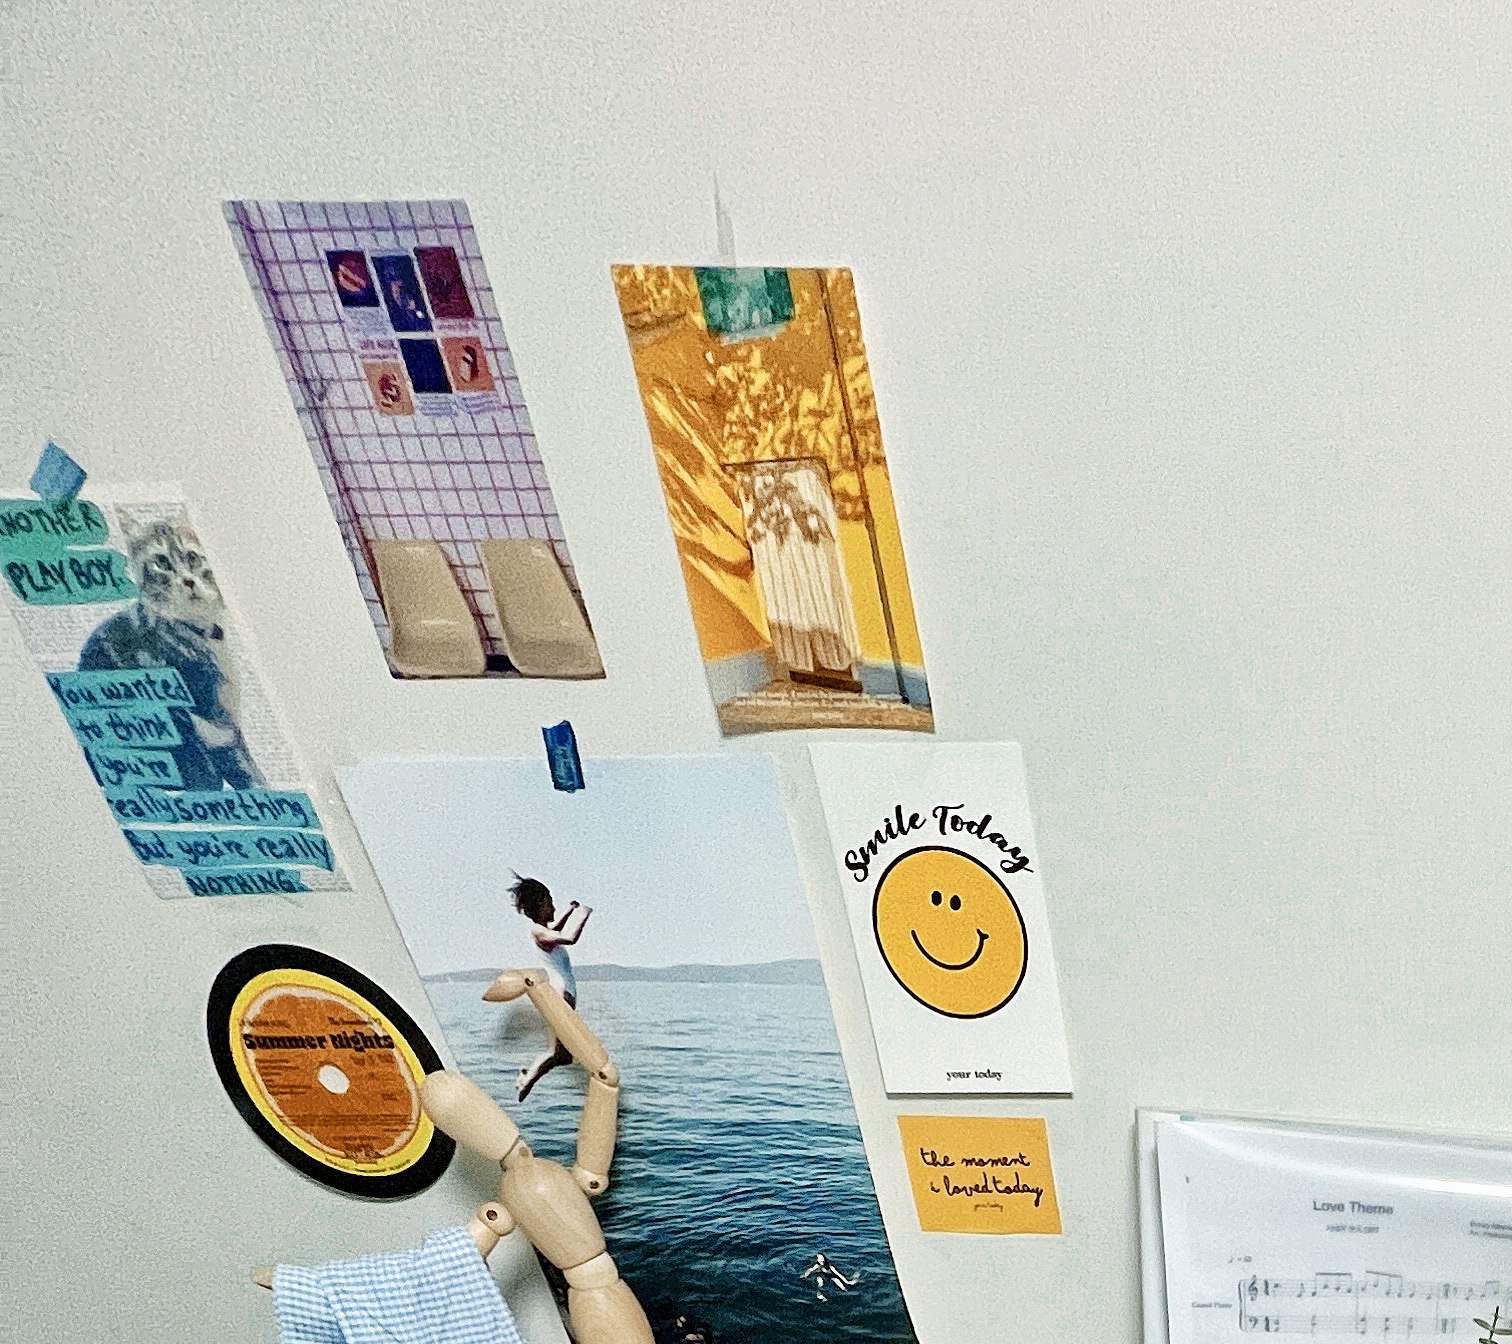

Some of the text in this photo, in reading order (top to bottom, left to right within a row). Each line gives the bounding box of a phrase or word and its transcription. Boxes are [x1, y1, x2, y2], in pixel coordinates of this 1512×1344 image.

[0, 501, 103, 538] NOTHER
[101, 673, 192, 701] wanted
[77, 712, 175, 742] to think
[175, 791, 310, 828] something
[255, 832, 336, 872] really
[845, 803, 1034, 883] Smile Today
[243, 1029, 396, 1053] Summer Nights
[946, 1068, 1003, 1081] your today
[920, 1147, 1030, 1167] the moment
[943, 1172, 993, 1196] loved
[992, 1171, 1043, 1208] today
[1312, 1200, 1394, 1215] Love Theme
